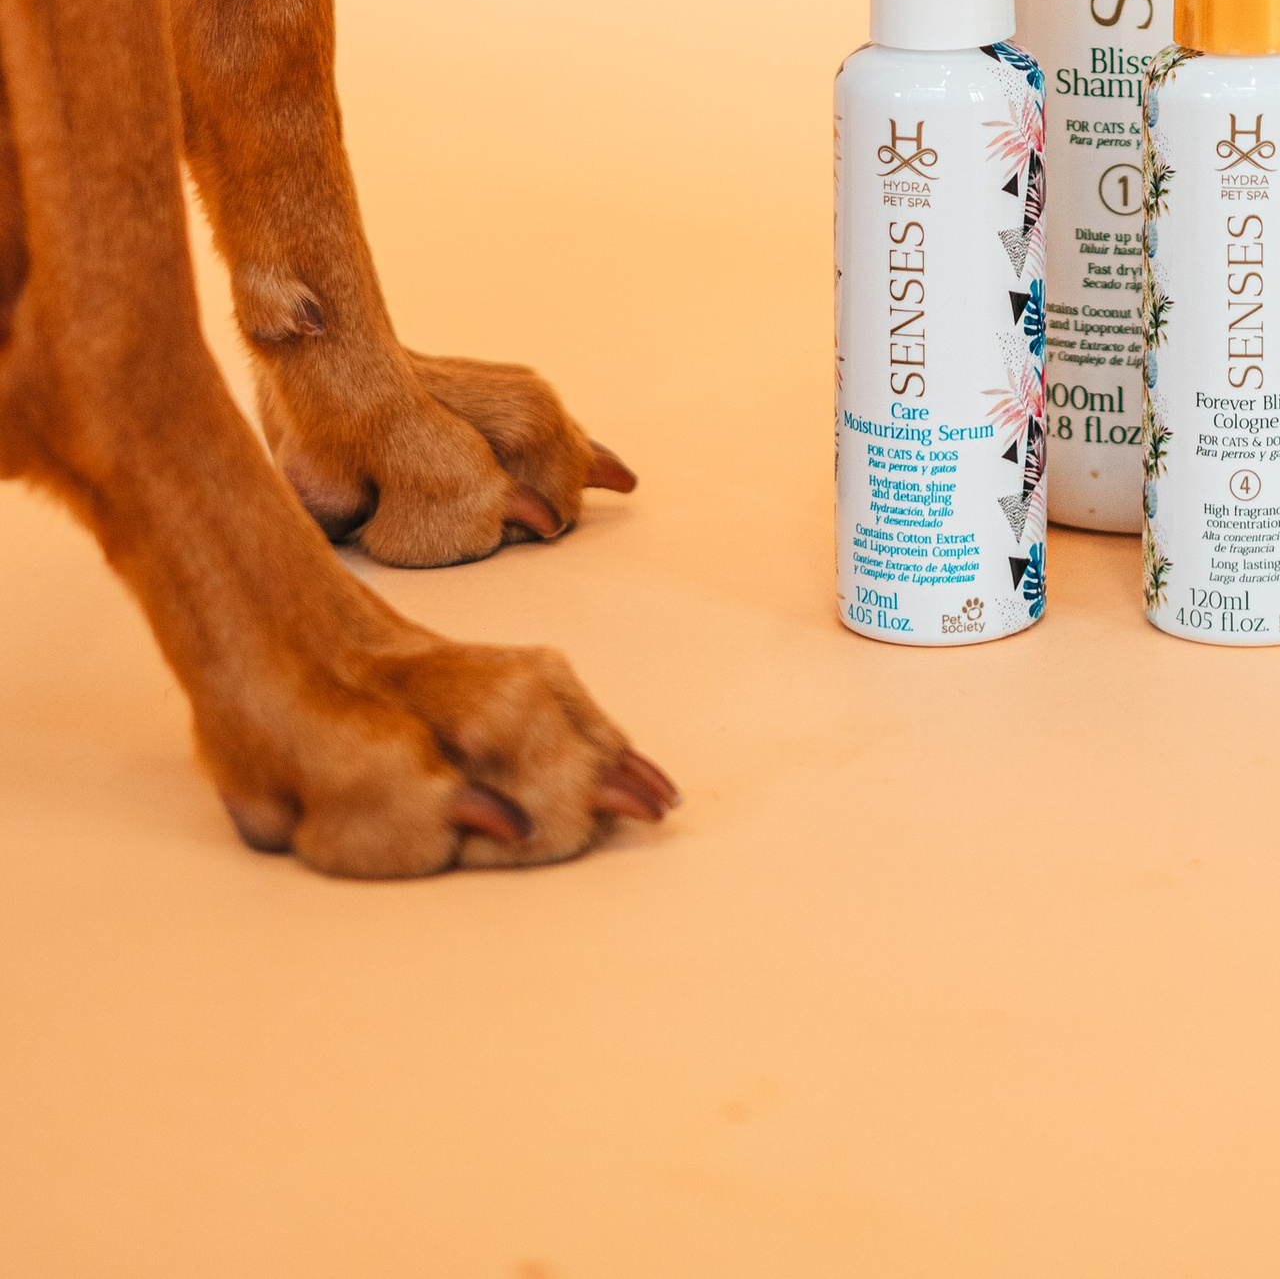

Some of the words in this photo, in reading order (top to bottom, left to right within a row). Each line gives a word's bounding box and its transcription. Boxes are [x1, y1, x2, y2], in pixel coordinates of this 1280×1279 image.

[1090, 47, 1152, 75] Bliss
[1066, 119, 1090, 132] FOR
[1094, 122, 1125, 134] CATS
[1129, 123, 1141, 134] &
[1069, 134, 1093, 146] Para
[1096, 137, 1132, 149] perros
[883, 179, 931, 193] HYDRA
[1221, 174, 1269, 186] HYDRA
[1117, 175, 1129, 207] 1
[1221, 190, 1243, 200] PET
[1246, 190, 1269, 200] SPA
[883, 195, 904, 207] PET
[907, 196, 931, 208] SPA
[1075, 228, 1111, 242] Dilute
[1115, 232, 1132, 245] up
[1079, 243, 1110, 255] Diluir
[1113, 245, 1142, 256] hasta
[1087, 262, 1112, 276] Fast
[1082, 277, 1121, 290] Secado
[889, 221, 926, 398] SENSES
[1226, 214, 1264, 390] SENSES
[1082, 304, 1131, 319] Coconut
[1049, 318, 1070, 330] and
[1046, 382, 1125, 413] 00ml
[1196, 391, 1256, 411] Forever
[890, 402, 930, 421] Care
[843, 409, 933, 447] Moisturizing
[938, 424, 994, 442] Serum
[1213, 412, 1279, 434] Cologne
[1199, 433, 1219, 446] FOR
[1221, 436, 1249, 447] CATS
[1252, 436, 1262, 447] &
[867, 443, 885, 457] FOR
[887, 448, 913, 460] CATS
[915, 450, 925, 461] &
[929, 450, 959, 462] DOGS
[1195, 445, 1218, 457] Para
[1221, 450, 1256, 461] perros
[1259, 450, 1266, 462] y
[868, 457, 886, 469] Para
[888, 463, 918, 473] perros
[921, 465, 929, 475] y
[930, 464, 957, 476] gatos
[868, 474, 922, 493] Hydration,
[925, 481, 957, 492] shine
[1239, 475, 1251, 494] 4
[872, 488, 890, 500] and
[893, 489, 952, 506] detangling
[928, 507, 954, 517] brillo
[1203, 502, 1230, 518] High
[875, 515, 882, 525] y
[883, 514, 944, 528] desenredado
[855, 522, 894, 541] Contains
[896, 531, 932, 544] Cotton
[936, 533, 975, 544] Extract
[1201, 530, 1220, 541] Alta
[853, 536, 867, 549] and
[870, 540, 928, 557] Lipoprotein
[932, 545, 980, 559] Complex
[1213, 543, 1227, 552] de
[1229, 543, 1275, 556] fragancia
[853, 551, 884, 567] Contiene
[885, 559, 923, 572] Extracto
[925, 562, 938, 572] de
[940, 561, 980, 574] Algodón
[1211, 557, 1239, 573] Long
[853, 564, 859, 574] y
[859, 564, 896, 581] Complejo
[898, 572, 909, 582] de
[1209, 571, 1236, 585] Larga
[856, 585, 899, 610] 120ml
[1189, 587, 1250, 611] 120ml
[847, 603, 873, 625] 4.05
[877, 610, 914, 632] fl.oz.
[941, 614, 962, 625] Pet
[1176, 607, 1213, 630] 4.05
[1221, 611, 1270, 633] fl.oz.
[941, 621, 986, 634] society
